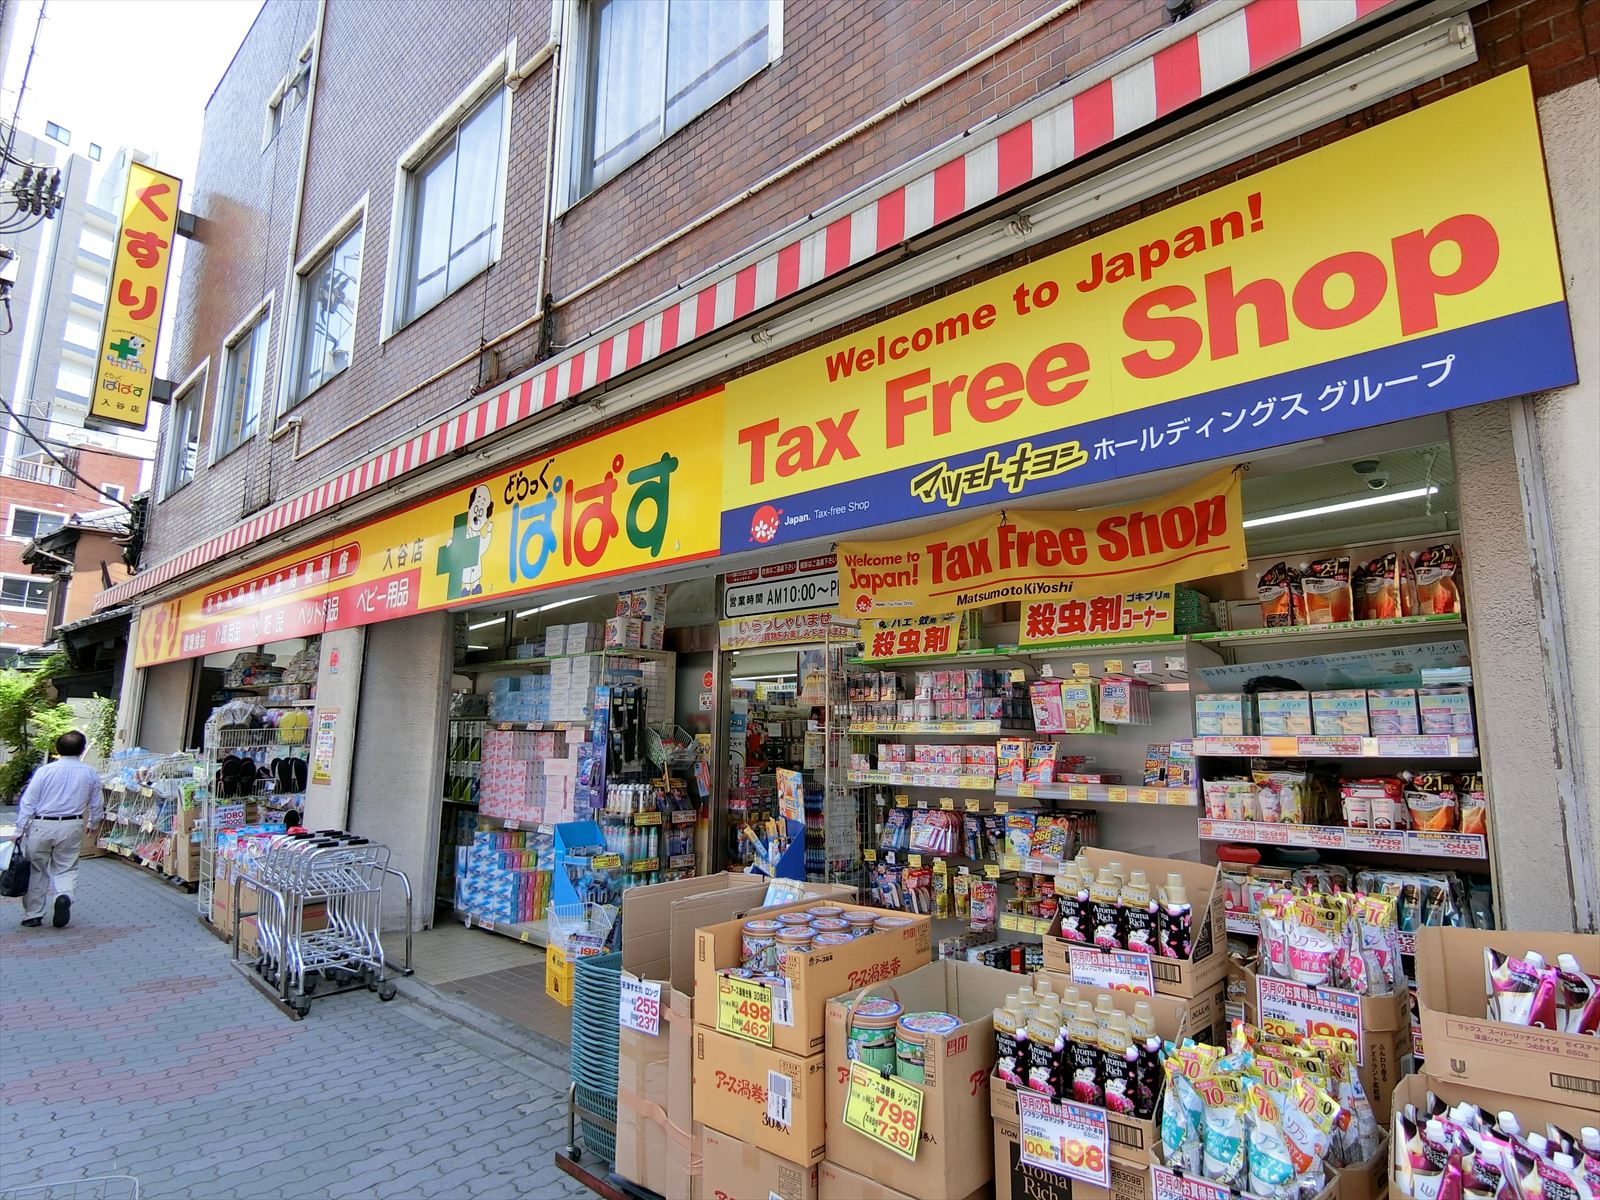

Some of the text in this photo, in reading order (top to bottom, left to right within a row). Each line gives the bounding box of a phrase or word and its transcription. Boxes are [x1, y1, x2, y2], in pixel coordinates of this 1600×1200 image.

[118, 183, 171, 320] くすり
[826, 192, 1264, 382] Welcome to Japan!
[738, 213, 1500, 485] Tax Free Shop
[911, 354, 1456, 504] マツモトキヨシ ホールディングス グループ
[504, 457, 556, 505] どらっぐ
[510, 452, 679, 583] ぱぱす
[784, 500, 870, 527] Japan. Tax-free Shop
[926, 494, 1227, 585] Tax Free Shop
[383, 539, 424, 571] 入谷店
[844, 551, 920, 567] Welcome to
[849, 563, 918, 595] Japan!
[299, 596, 340, 626] ペット用品
[356, 577, 409, 613] ベビー用品
[729, 592, 763, 608] 営業時間
[956, 581, 1073, 606] MatsumotoKiYoshi
[1126, 591, 1170, 603] ゴキブリ用
[739, 612, 831, 634] いらっしゃいませ
[1025, 594, 1122, 638] 殺虫剤
[1122, 606, 1168, 628] コーナー
[141, 600, 182, 662] くすり
[871, 625, 950, 657] 殺虫剤
[224, 806, 244, 819] 1080
[1059, 898, 1079, 909] Aroma
[1061, 906, 1076, 915] Rich
[1093, 905, 1117, 915] Aroma
[1097, 913, 1113, 922] Rich
[1125, 909, 1149, 920] Aroma
[1129, 918, 1145, 927] Rich
[1300, 910, 1316, 927] 10
[848, 956, 901, 990] アース渦巻香
[645, 987, 659, 998] ロング
[636, 996, 658, 1017] 255
[739, 1000, 770, 1023] 498
[639, 1015, 656, 1031] 237
[743, 1020, 767, 1039] 462
[996, 1034, 1016, 1047] Aroma
[1458, 1023, 1482, 1033] ラックス
[1488, 1028, 1558, 1045] スーパーリッチシャイン
[1474, 1033, 1519, 1046] 保湿シャンプー
[1525, 1042, 1560, 1053] つめかえ用
[998, 1045, 1013, 1055] Rich
[1028, 1044, 1052, 1058] Aroma
[1031, 1054, 1048, 1066] Rich
[1071, 1045, 1097, 1057] Aroma
[1075, 1055, 1093, 1066] Rich
[1102, 1054, 1127, 1069] Aroma
[1183, 1060, 1200, 1079] 10
[1105, 1065, 1123, 1077] Rich
[1262, 1068, 1279, 1088] 10
[715, 1070, 769, 1103] アース渦巻
[1203, 1087, 1225, 1106] 10
[898, 1093, 917, 1109] ジャンボ
[876, 1095, 916, 1131] 798
[880, 1120, 909, 1148] 739
[1000, 1128, 1018, 1139] LION
[1015, 1160, 1068, 1190] Aroma
[1024, 1175, 1059, 1200] Rich
